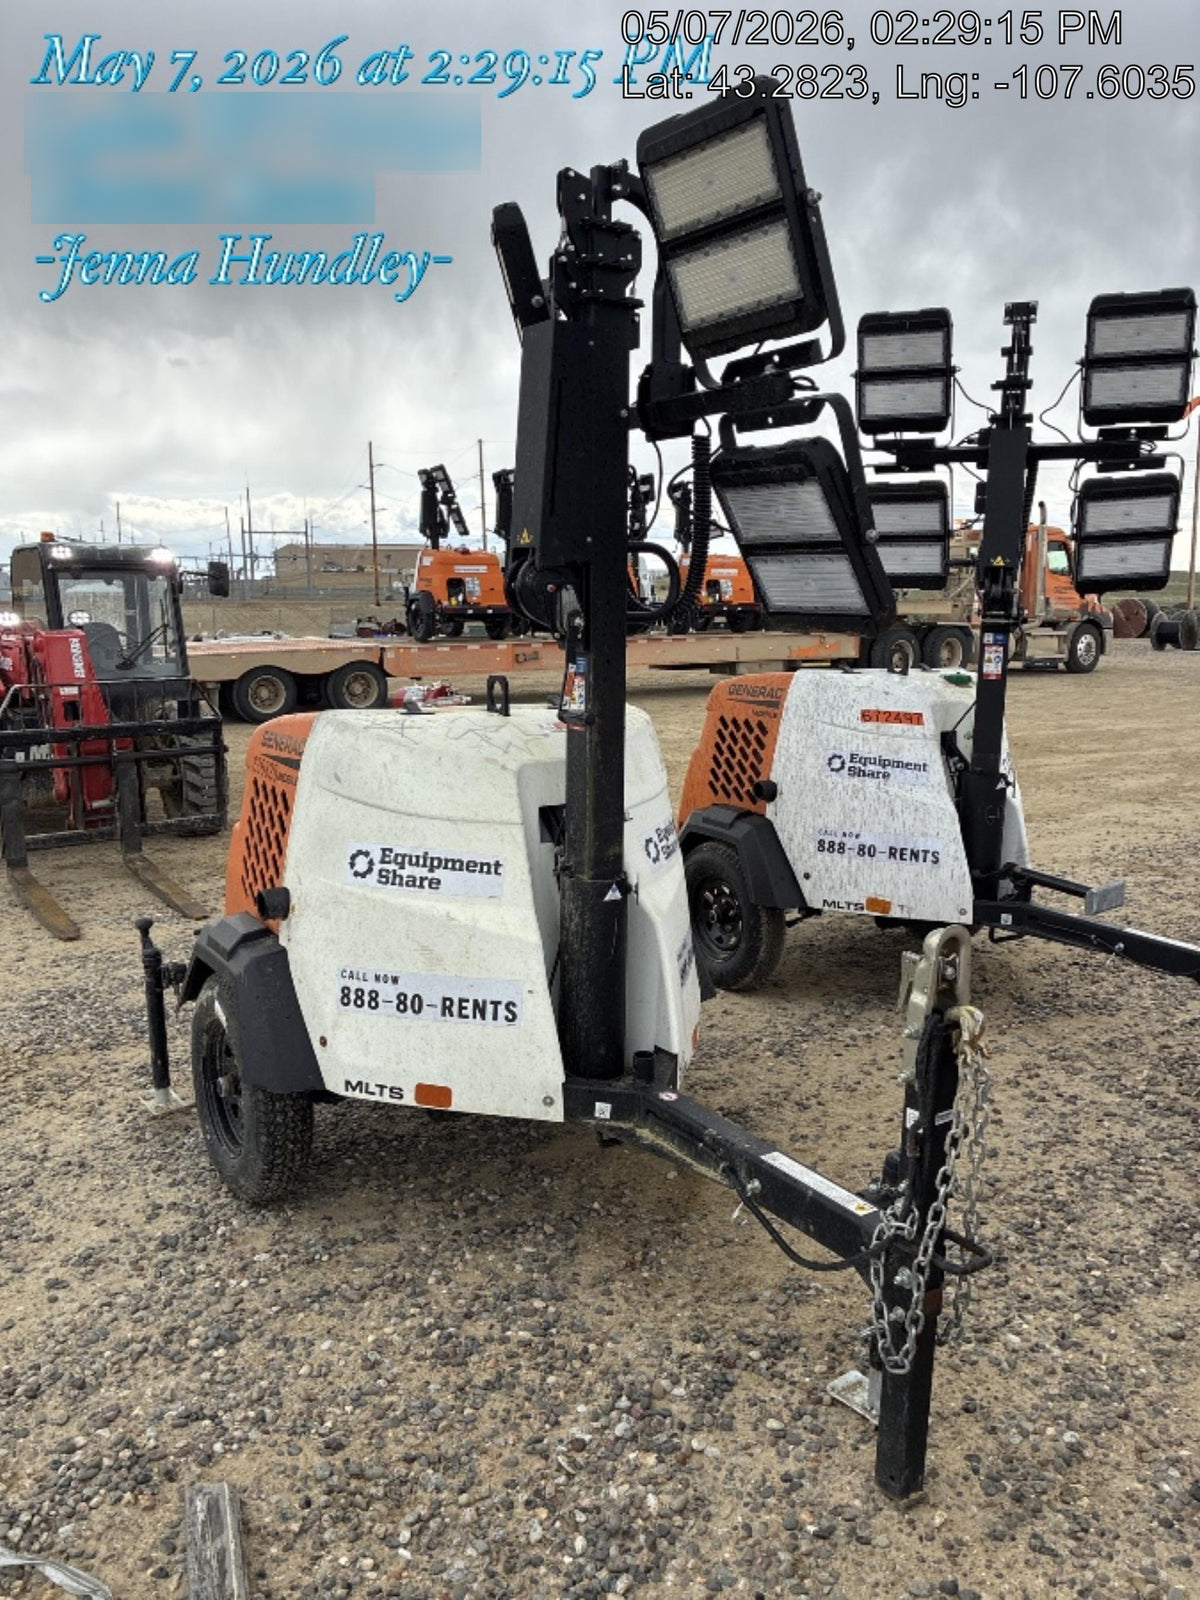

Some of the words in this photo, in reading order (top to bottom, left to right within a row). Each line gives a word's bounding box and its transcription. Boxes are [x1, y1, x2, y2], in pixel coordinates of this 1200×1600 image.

[728, 683, 783, 699] GENERAC
[847, 766, 891, 780] Share
[848, 753, 928, 773] Equipment
[817, 839, 940, 864] 888-80-RENTS
[379, 848, 503, 876] Equipment
[377, 867, 442, 890] Share
[822, 899, 864, 911] MLTS
[341, 969, 369, 982] CALL
[374, 973, 400, 985] NOW
[340, 986, 518, 1023] 888-80-RENTS
[344, 1079, 404, 1099] MLTS
